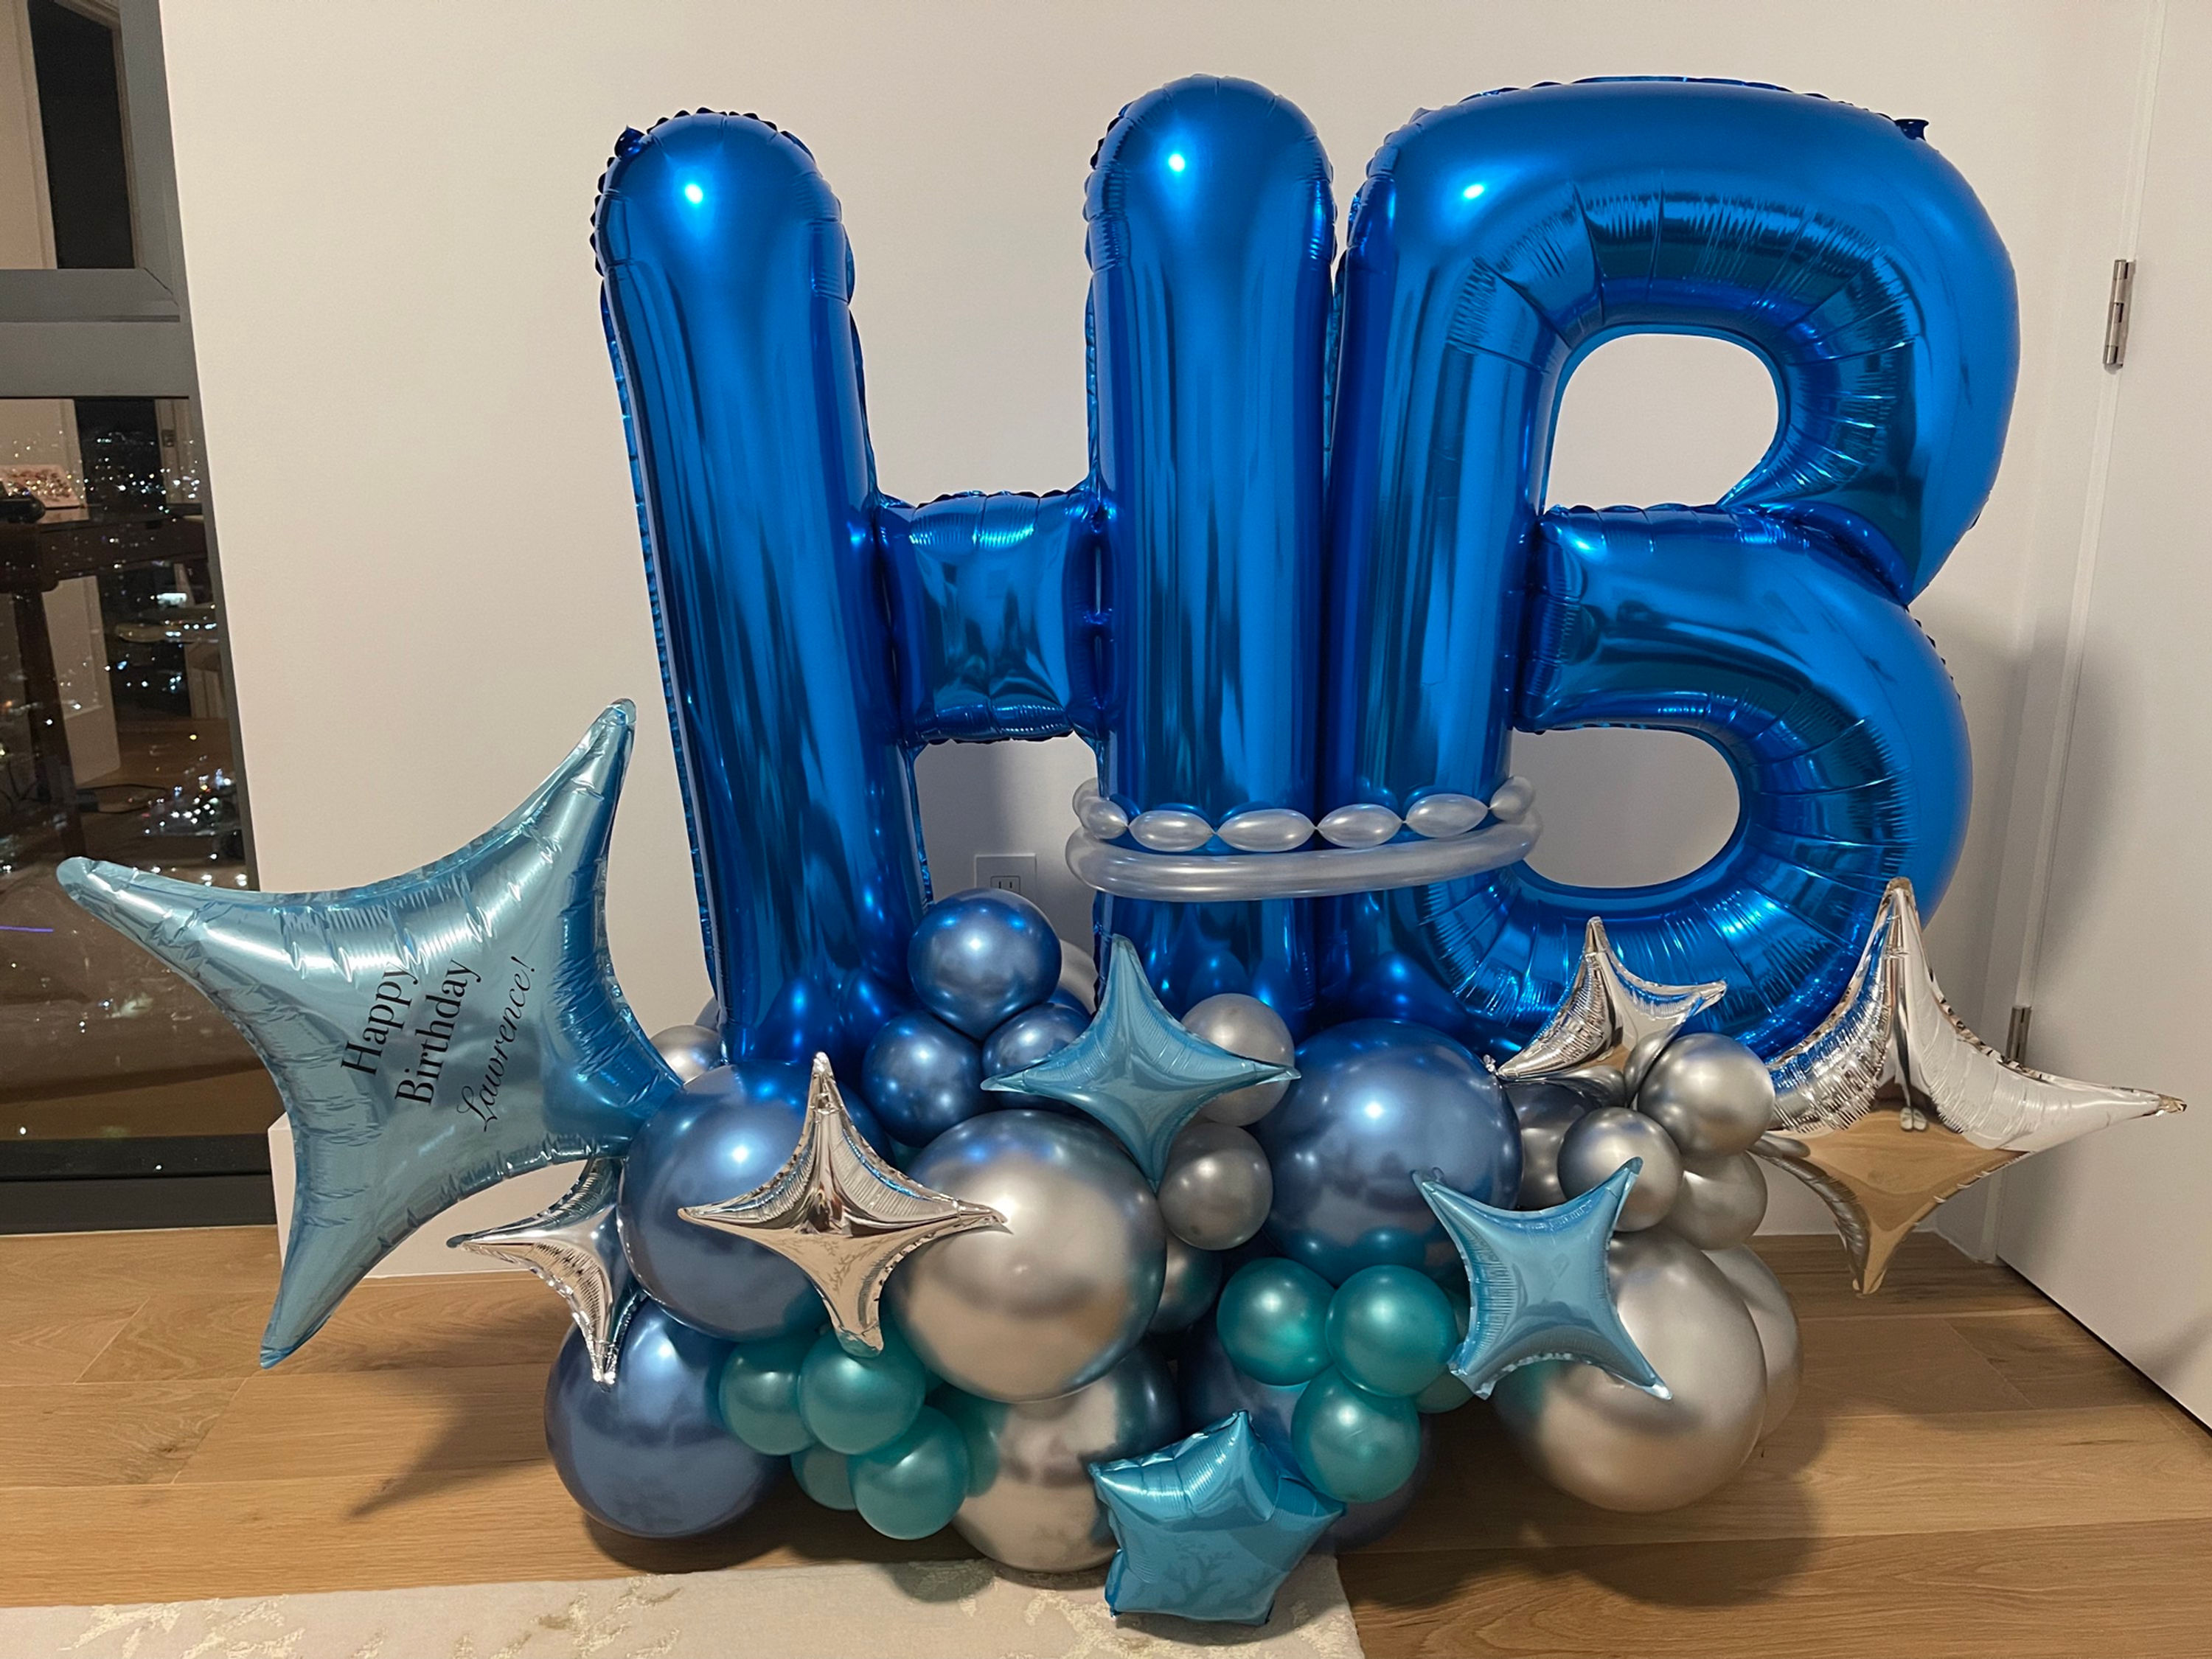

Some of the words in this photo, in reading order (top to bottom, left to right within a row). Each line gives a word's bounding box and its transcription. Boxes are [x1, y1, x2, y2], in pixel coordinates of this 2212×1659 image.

[341, 961, 418, 1076] Happy
[394, 959, 481, 1105] Birthday
[457, 956, 535, 1132] Lawrence!
